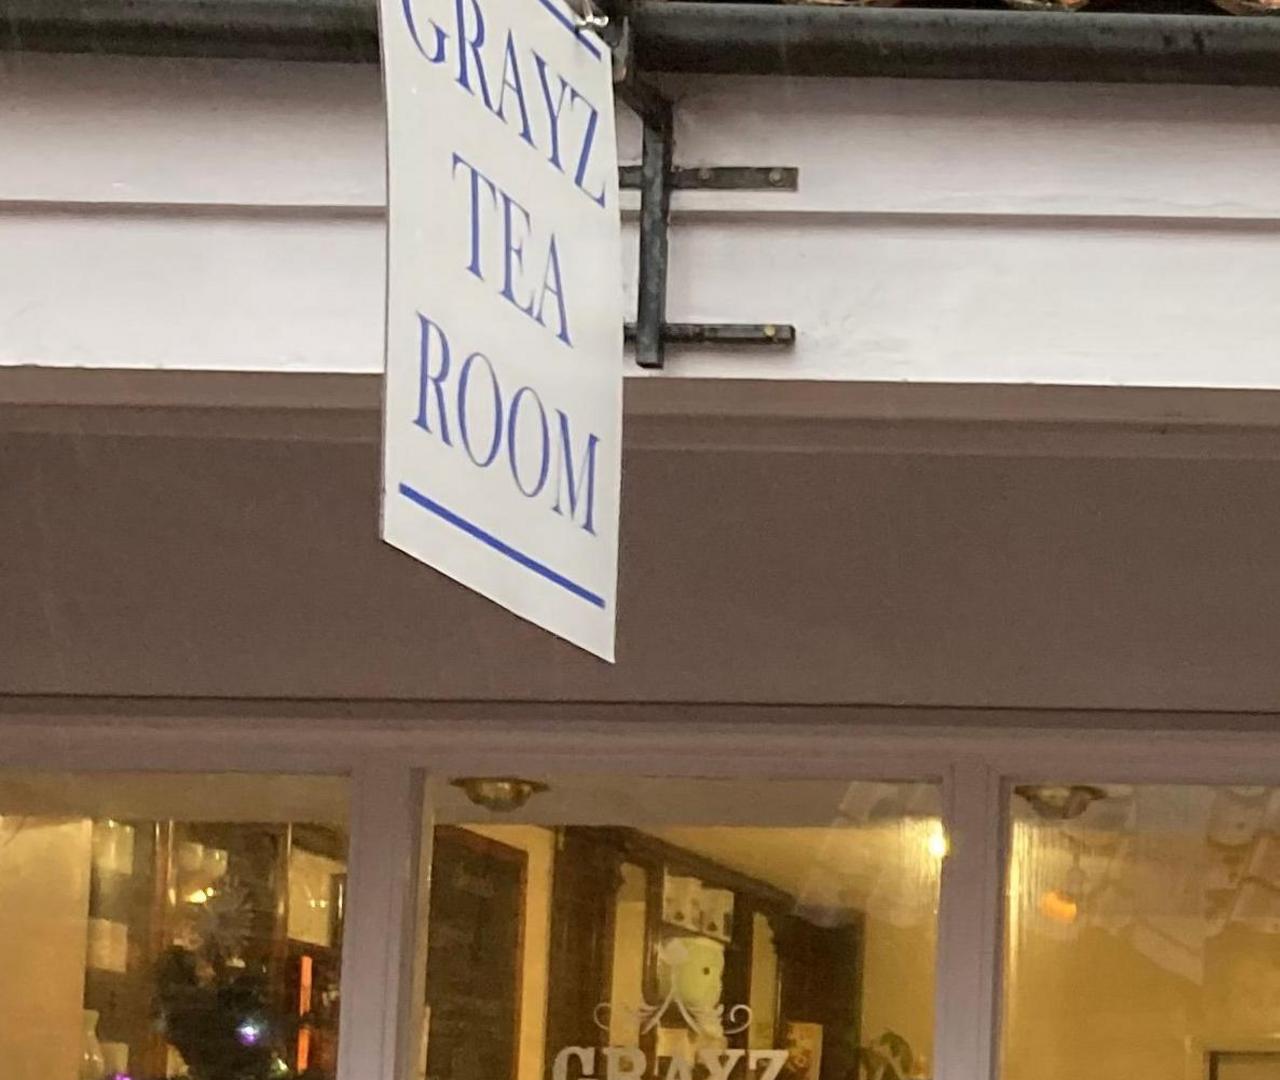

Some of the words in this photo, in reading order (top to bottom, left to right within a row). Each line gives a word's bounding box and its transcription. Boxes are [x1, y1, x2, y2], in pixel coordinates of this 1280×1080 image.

[401, 0, 607, 209] GRAYZ
[451, 152, 574, 348] TEA
[412, 310, 601, 537] ROOM
